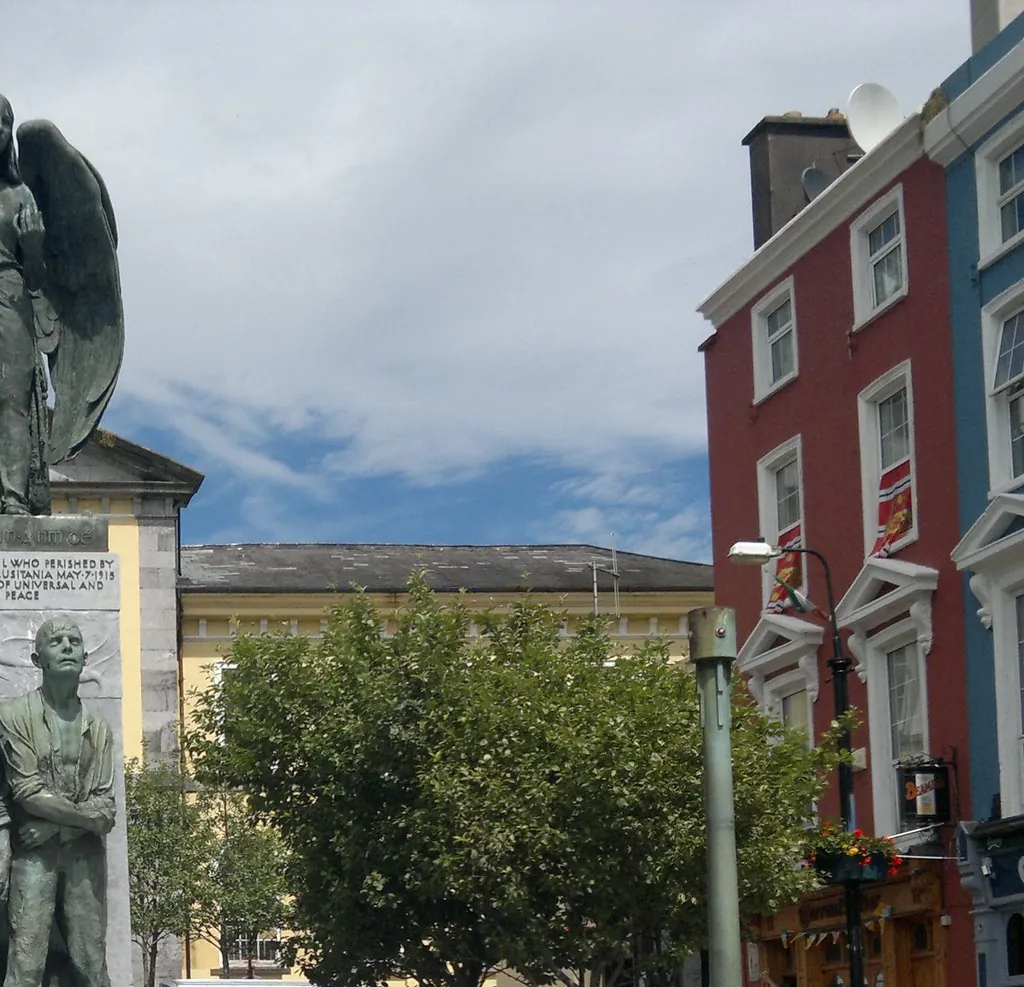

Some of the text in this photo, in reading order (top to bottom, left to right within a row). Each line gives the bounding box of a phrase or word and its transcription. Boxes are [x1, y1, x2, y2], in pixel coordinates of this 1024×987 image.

[10, 558, 40, 569] WHO
[45, 559, 97, 569] PERISHED
[100, 559, 115, 569] BY
[15, 581, 76, 590] UNIVERSAL
[79, 581, 104, 590] AND
[6, 591, 39, 601] PEACE
